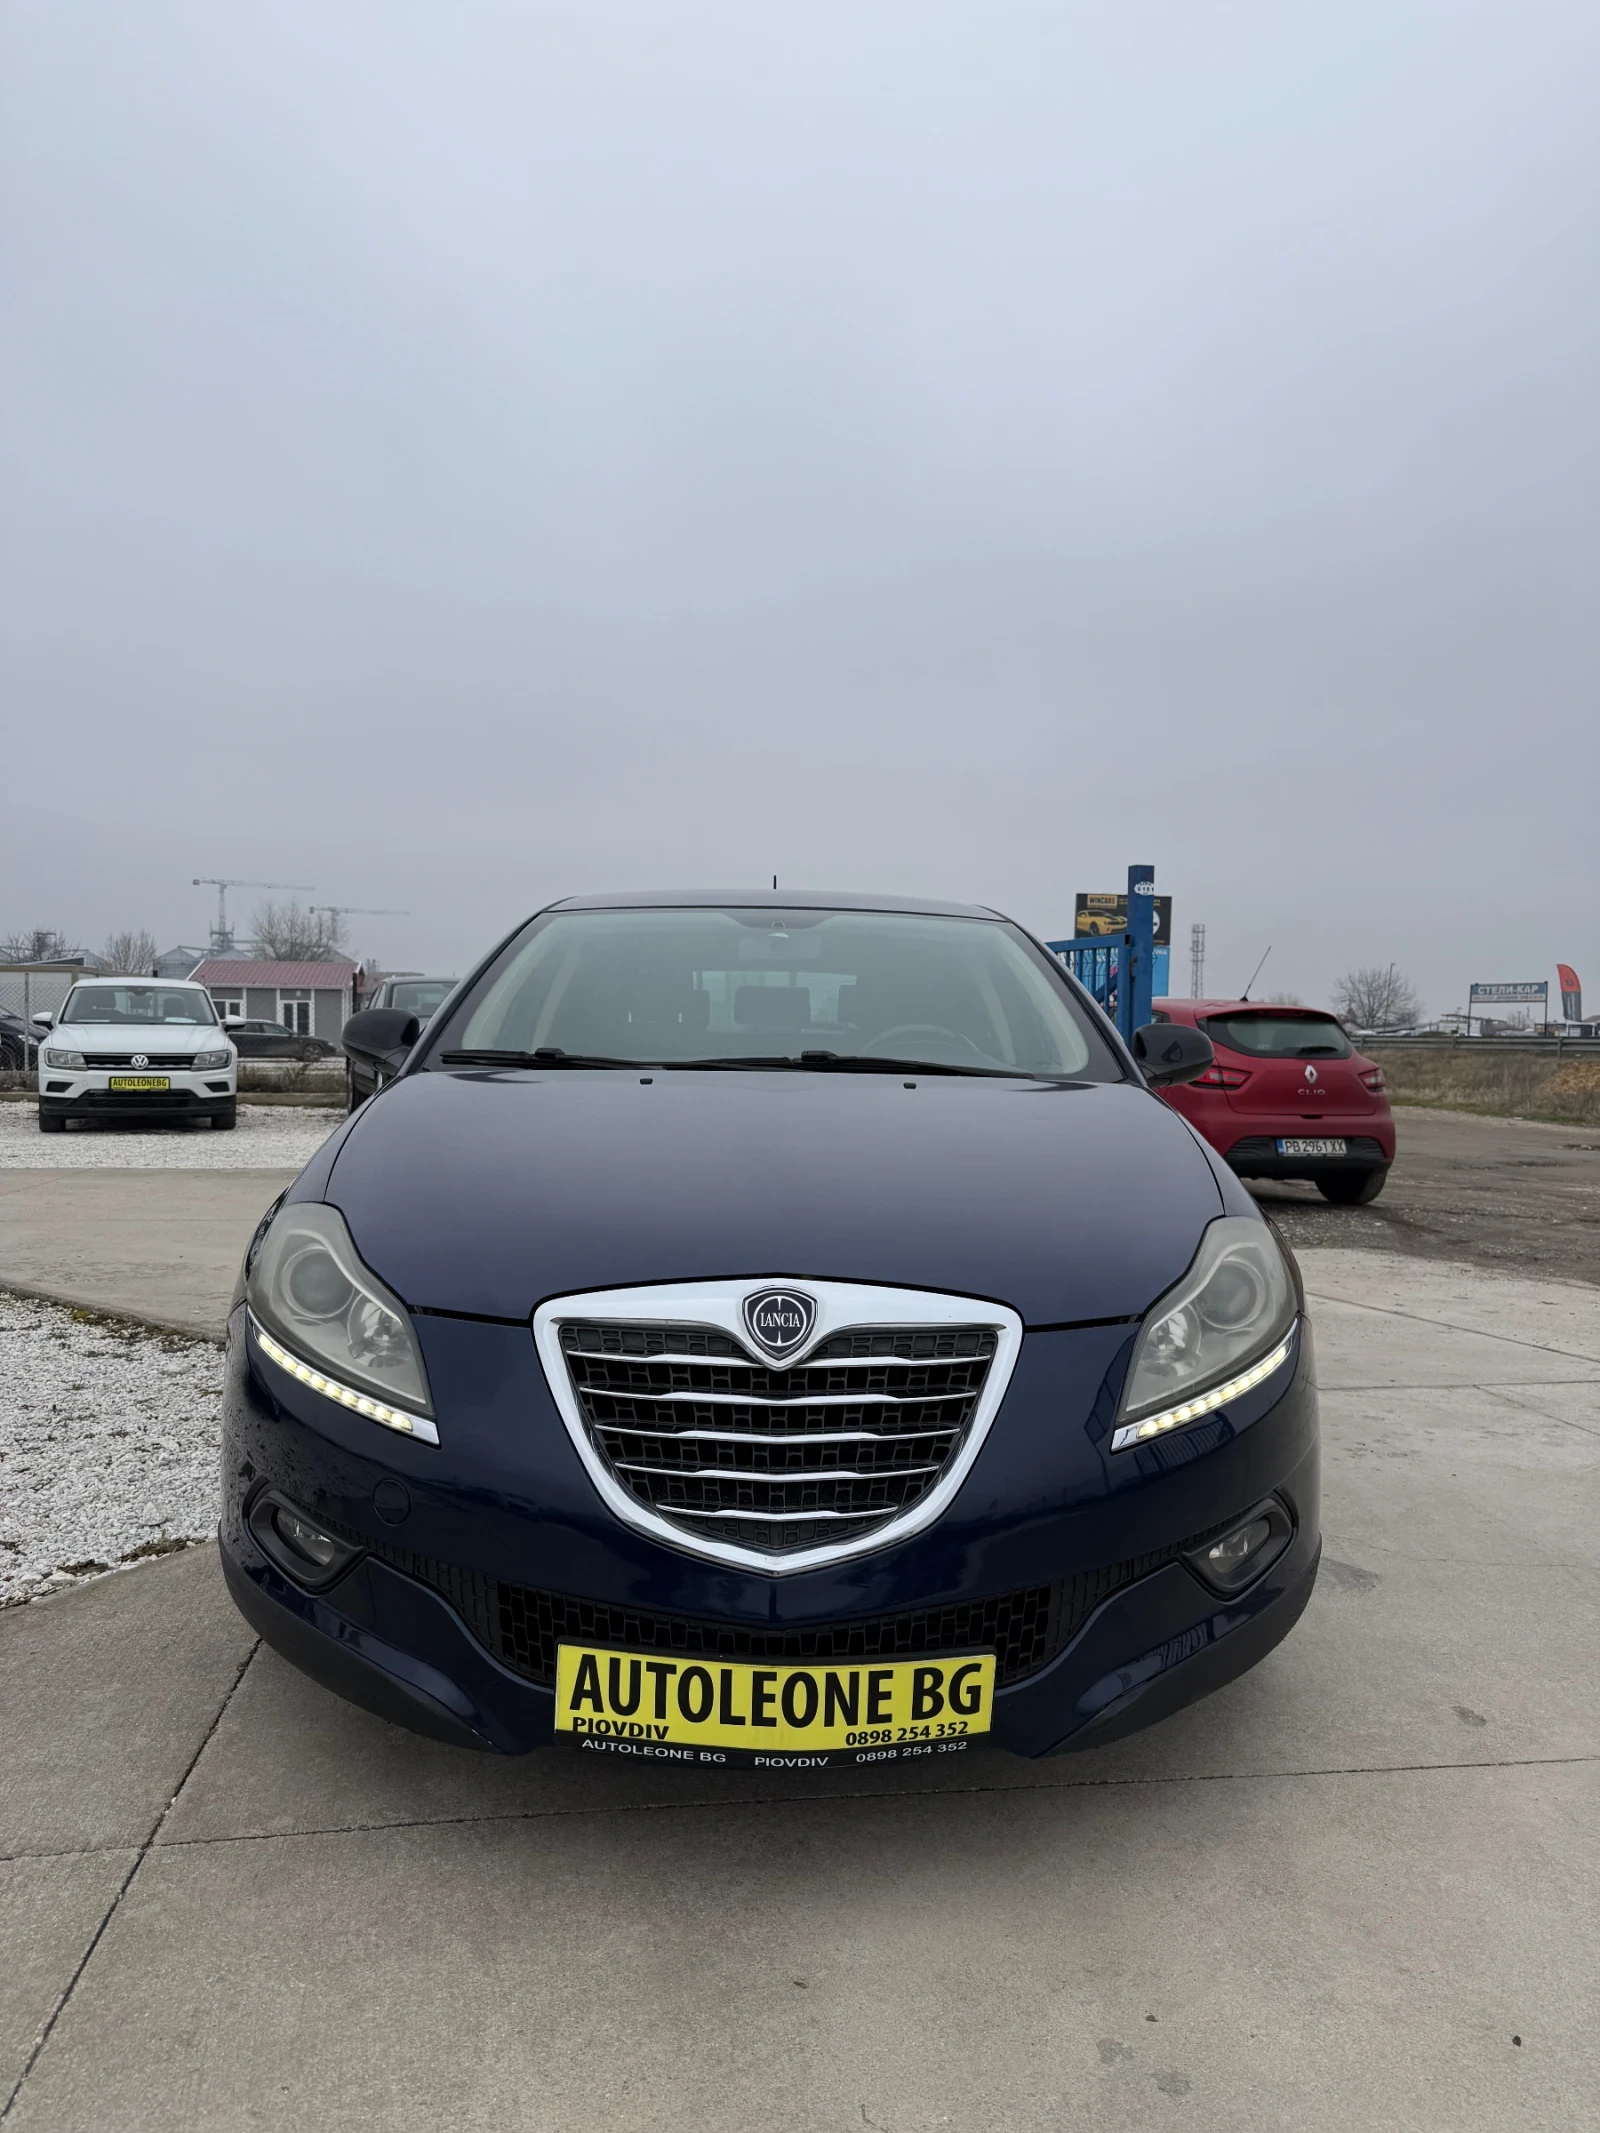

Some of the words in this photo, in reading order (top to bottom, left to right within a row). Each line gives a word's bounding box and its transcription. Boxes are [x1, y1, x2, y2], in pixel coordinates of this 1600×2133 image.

[1478, 985, 1539, 994] СТЕЛИ-КАР
[113, 1079, 167, 1087] AUTOLEONEBG
[1297, 1088, 1326, 1096] CLIO
[760, 1312, 801, 1328] LANCIA
[569, 1653, 894, 1729] AUTOLEONE
[911, 1663, 982, 1721] BG
[845, 1729, 892, 1747] 0898
[896, 1723, 931, 1742] 254
[935, 1720, 969, 1738] 352
[581, 1739, 694, 1760] AUTOLEONE
[699, 1751, 727, 1763] BG
[856, 1749, 898, 1764] 0898
[902, 1744, 933, 1757] 254
[937, 1740, 968, 1752] 352
